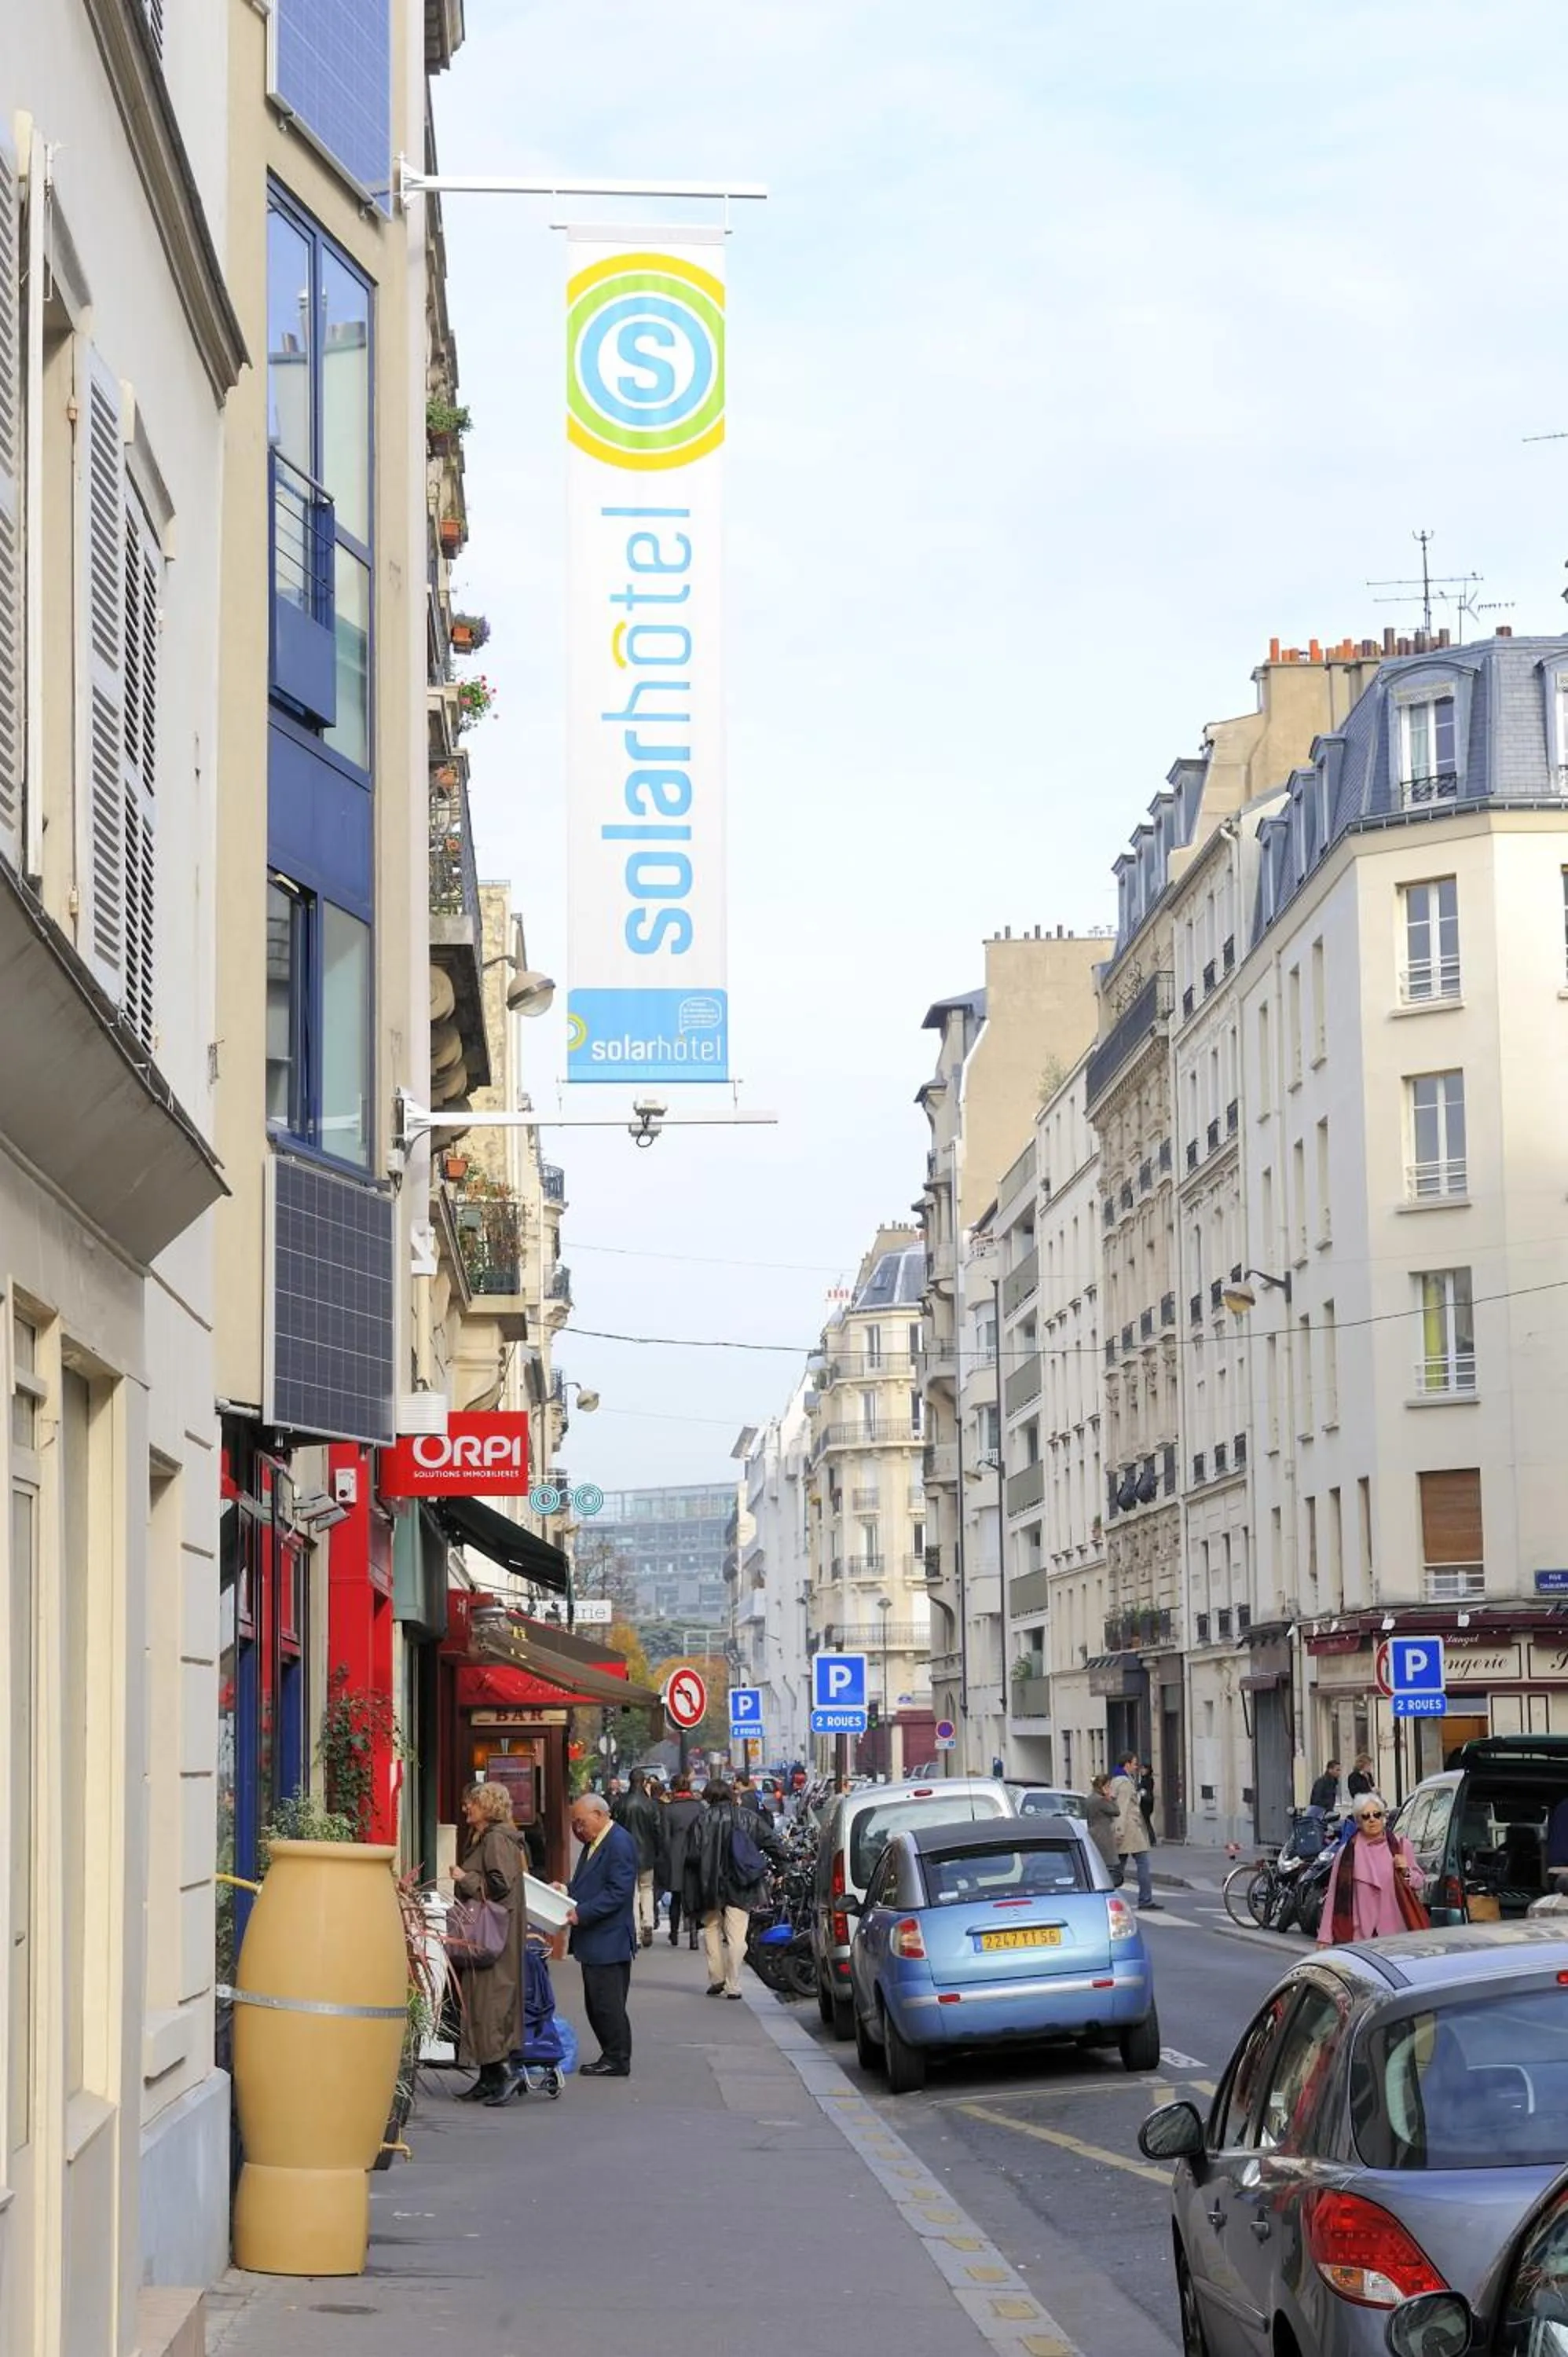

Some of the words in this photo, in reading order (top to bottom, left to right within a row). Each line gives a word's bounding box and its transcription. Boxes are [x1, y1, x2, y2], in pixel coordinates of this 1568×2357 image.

[601, 507, 693, 955] solarhôtel
[412, 1435, 521, 1468] ORPI
[1405, 1648, 1427, 1682] P
[829, 1665, 852, 1698] P
[495, 1708, 544, 1721] BAR
[738, 1695, 753, 1717] P
[1397, 1700, 1405, 1710] 2
[1409, 1699, 1442, 1710] ROUES
[816, 1716, 823, 1727] 2
[827, 1716, 862, 1727] ROUES
